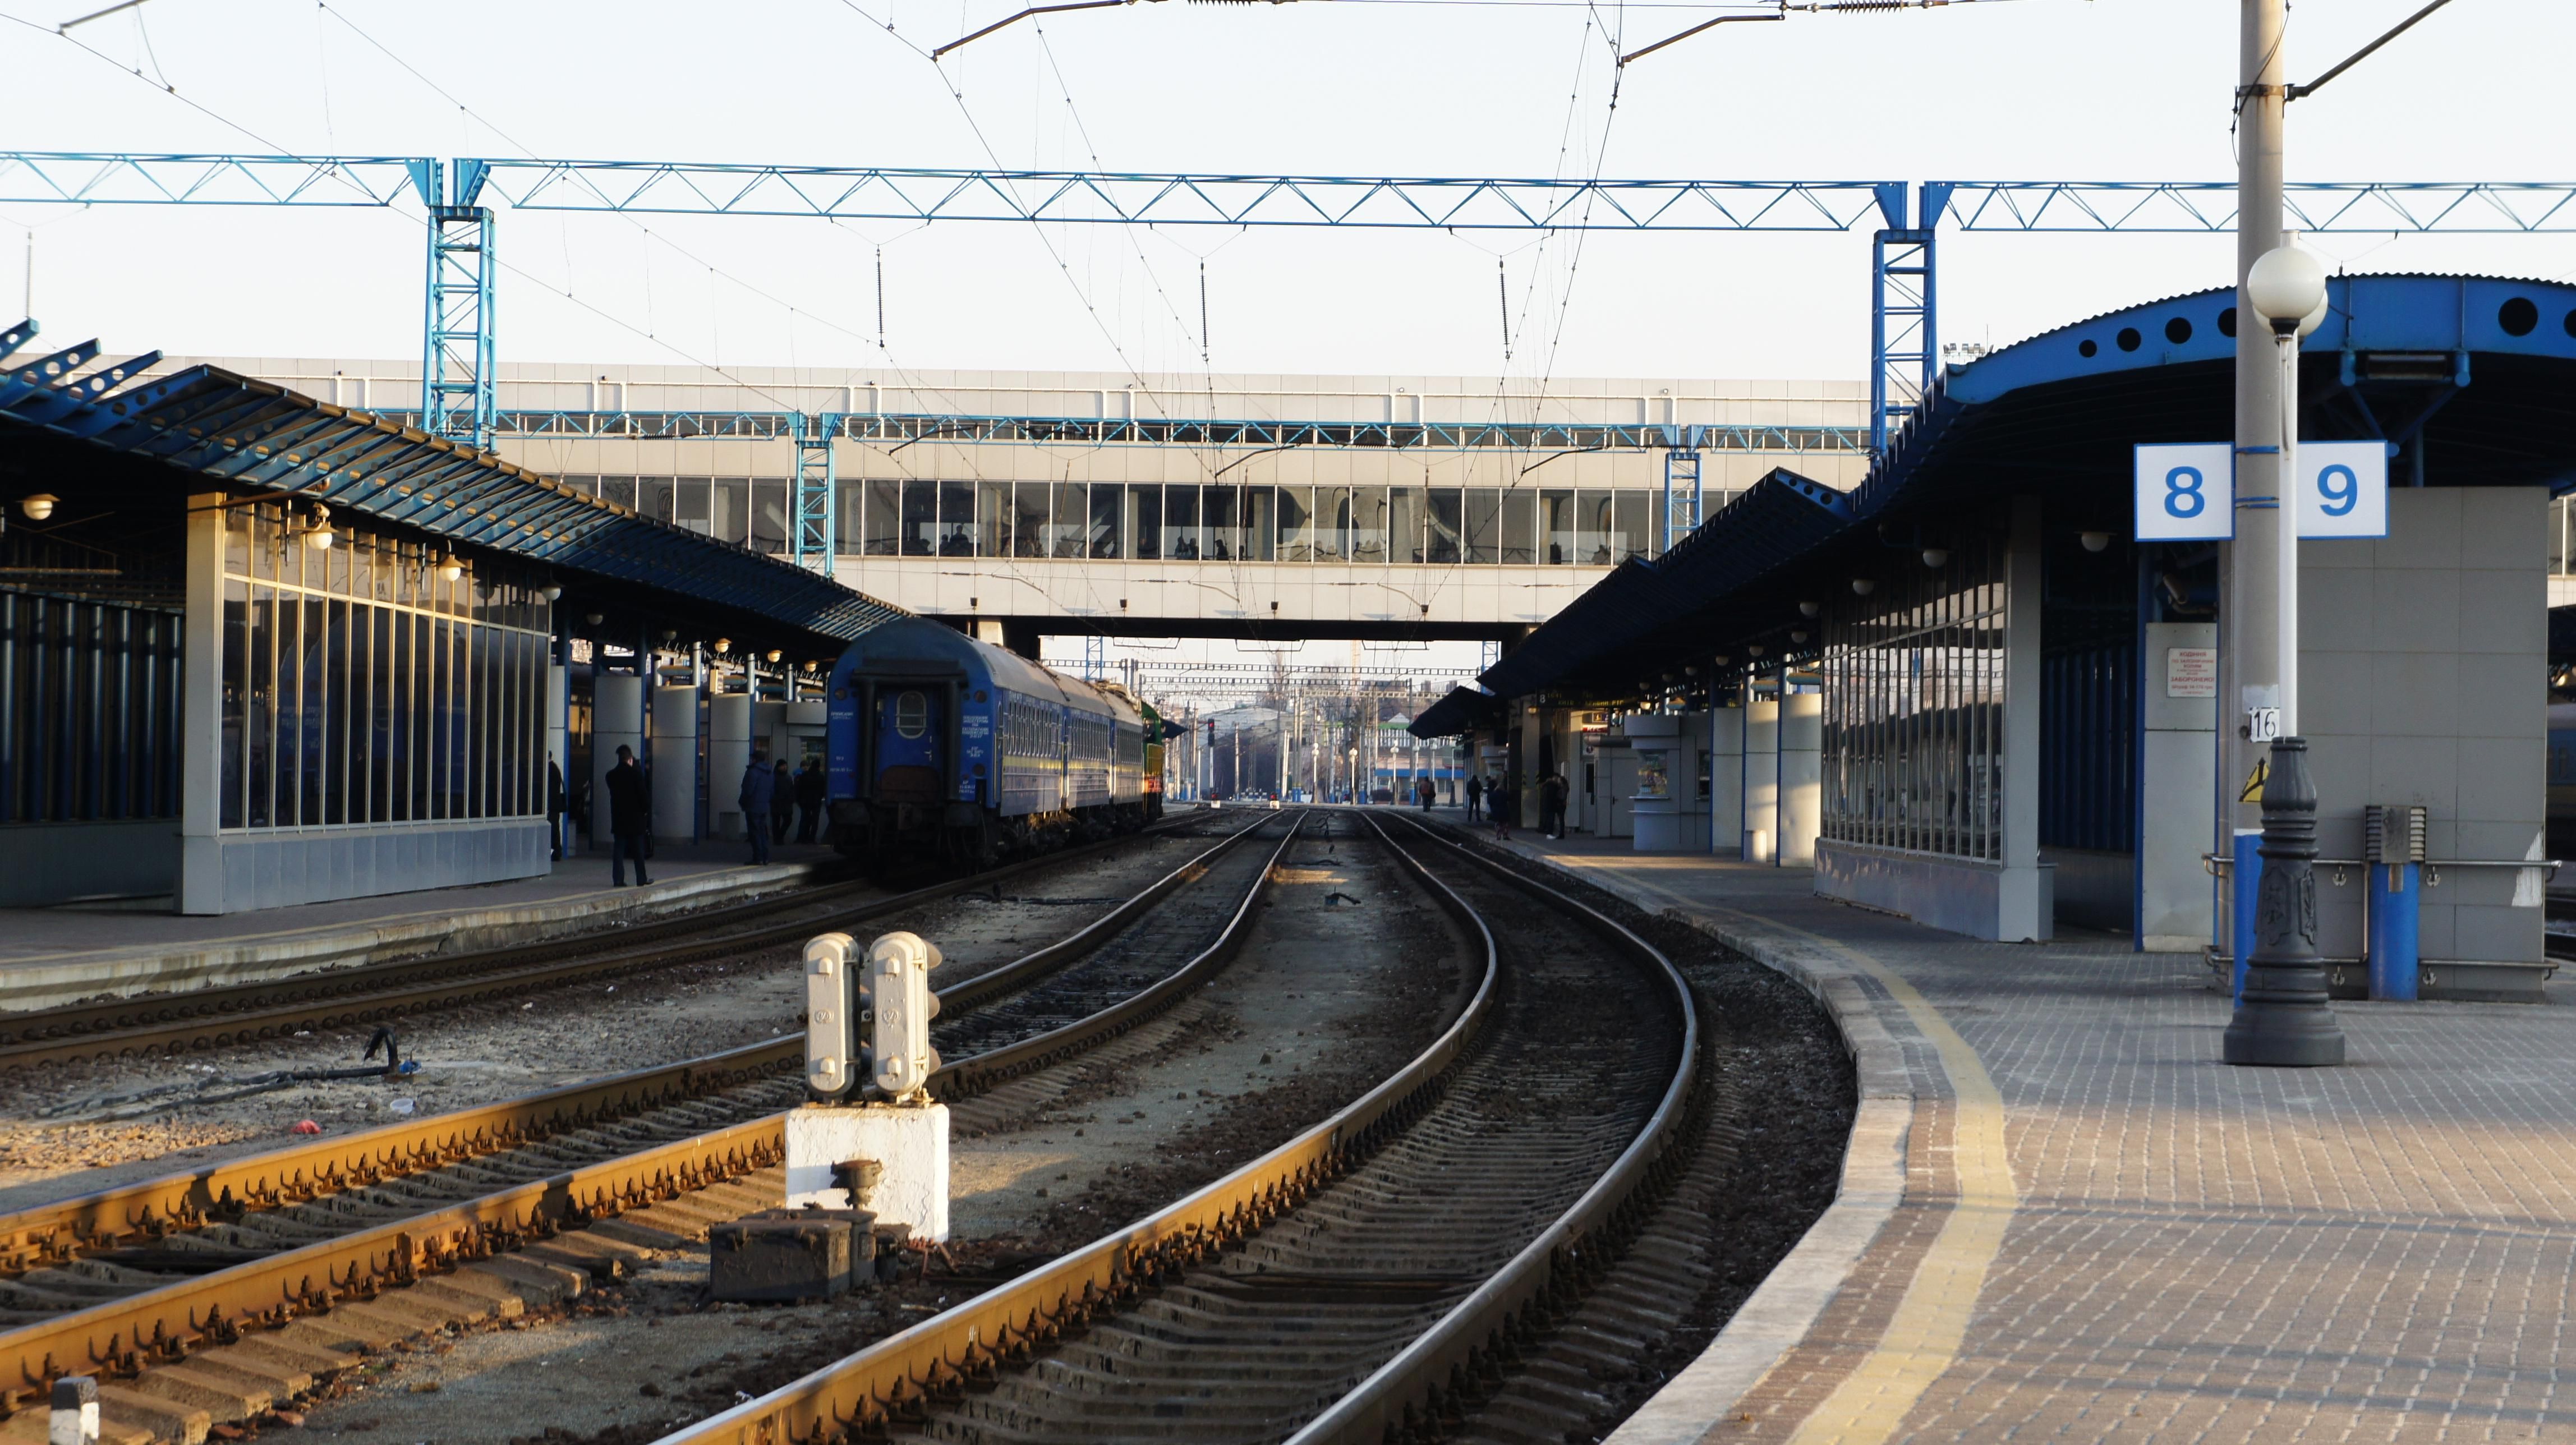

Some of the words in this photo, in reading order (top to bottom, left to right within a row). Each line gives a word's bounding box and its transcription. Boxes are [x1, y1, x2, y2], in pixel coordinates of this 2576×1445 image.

[2164, 466, 2205, 518] 8
[2317, 464, 2358, 516] 9
[1539, 694, 1546, 703] 8
[2254, 711, 2276, 738] 16
